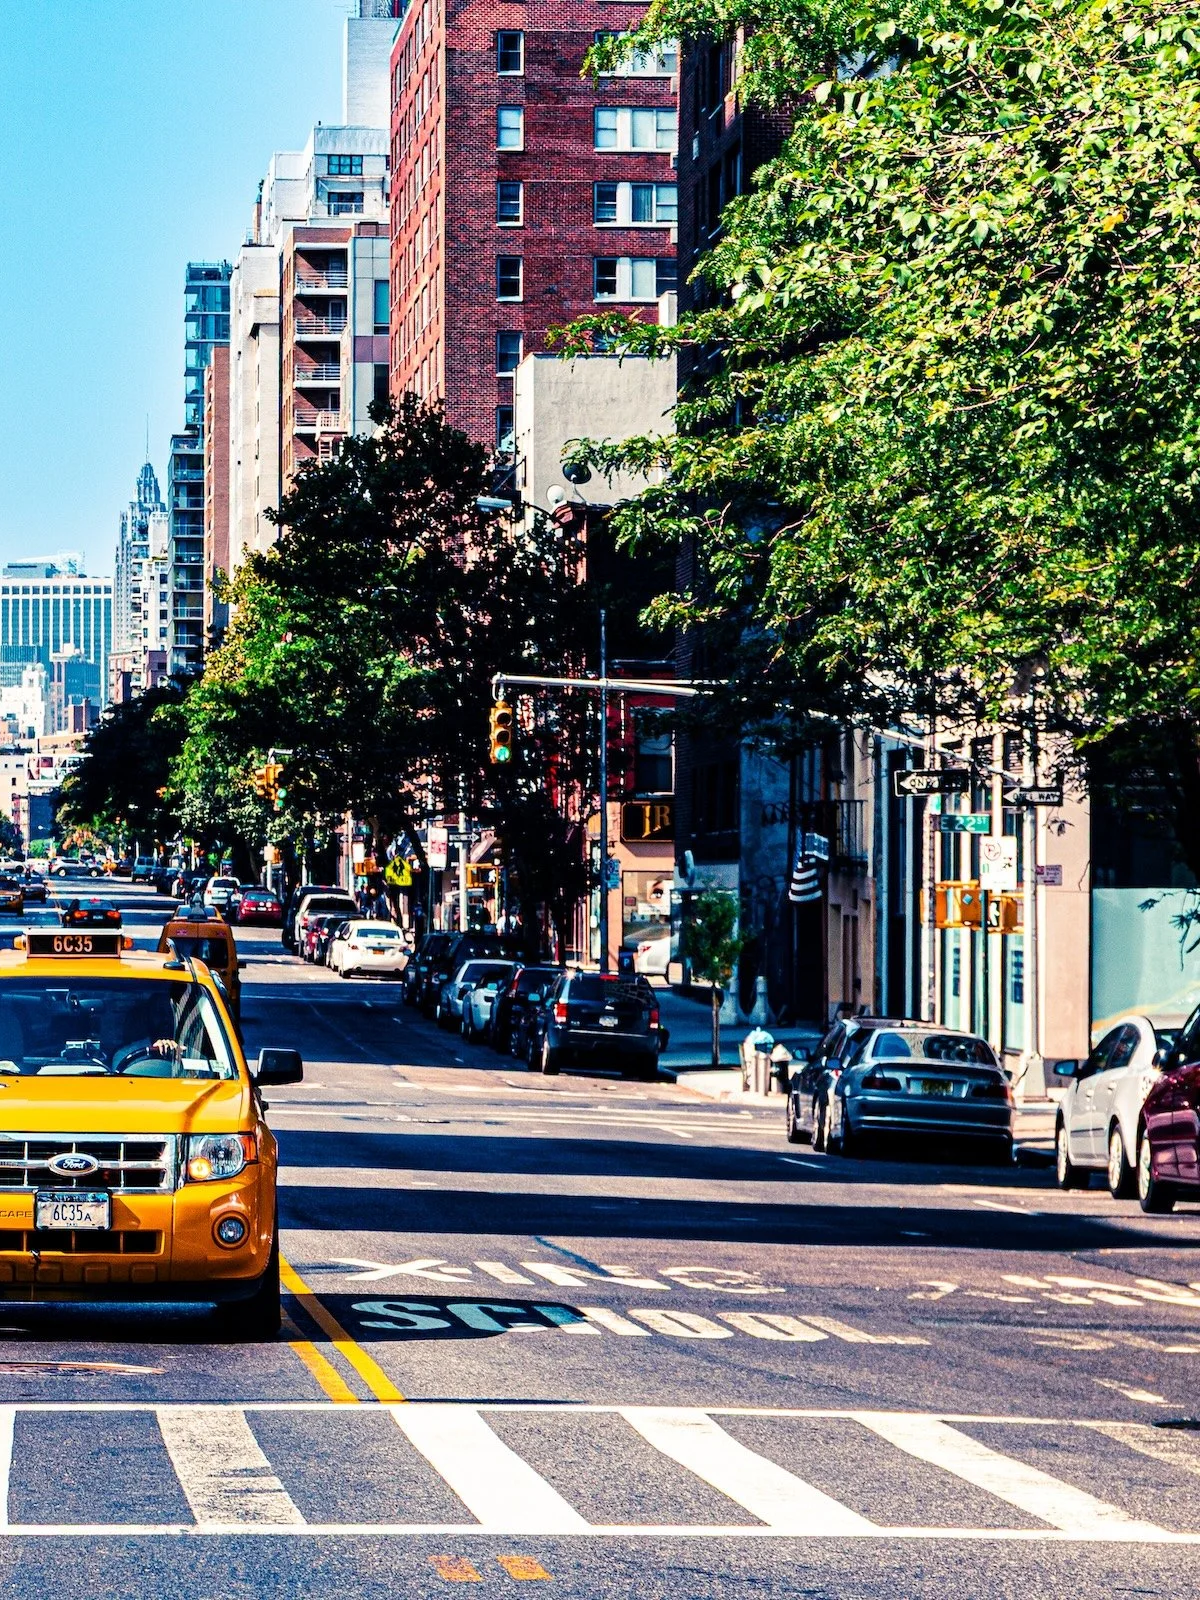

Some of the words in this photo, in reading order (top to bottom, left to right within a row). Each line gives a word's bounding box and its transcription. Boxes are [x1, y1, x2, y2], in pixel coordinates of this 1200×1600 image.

[955, 817, 976, 830] 22
[53, 935, 93, 952] 6C35
[62, 1159, 86, 1169] Ford
[351, 1301, 932, 1345] SCHOOL
